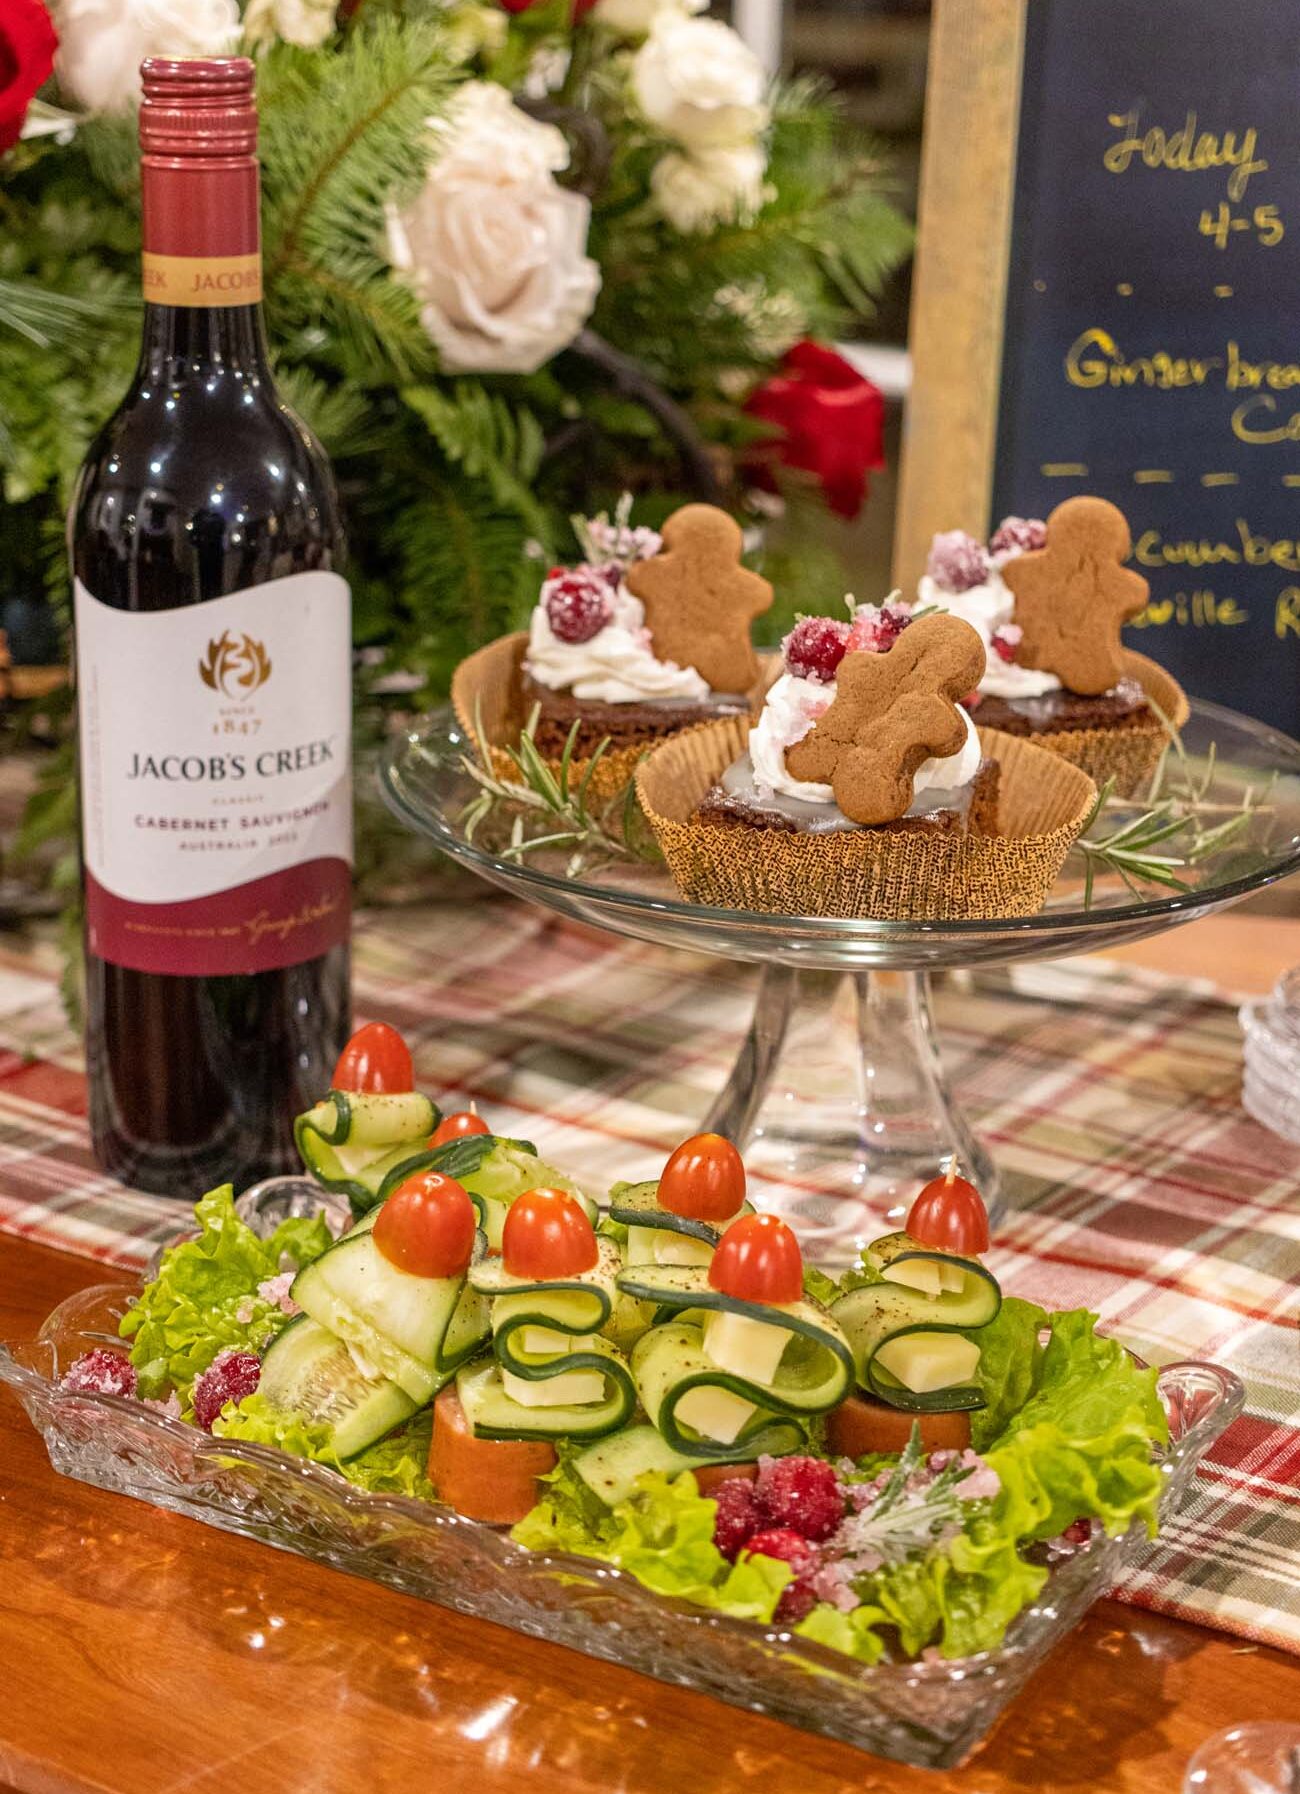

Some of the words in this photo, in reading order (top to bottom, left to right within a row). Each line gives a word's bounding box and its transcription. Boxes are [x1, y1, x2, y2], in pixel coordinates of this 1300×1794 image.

[1103, 106, 1269, 203] Today
[1198, 201, 1284, 249] 4-5
[1129, 518, 1300, 571] cumbe
[212, 718, 263, 737] 1847
[127, 752, 246, 781] JACOB'S
[255, 738, 335, 777] CREEK
[134, 813, 229, 831] CABERNET
[239, 800, 330, 830] SAUVIGNON
[178, 839, 257, 851] AUSTRALIA
